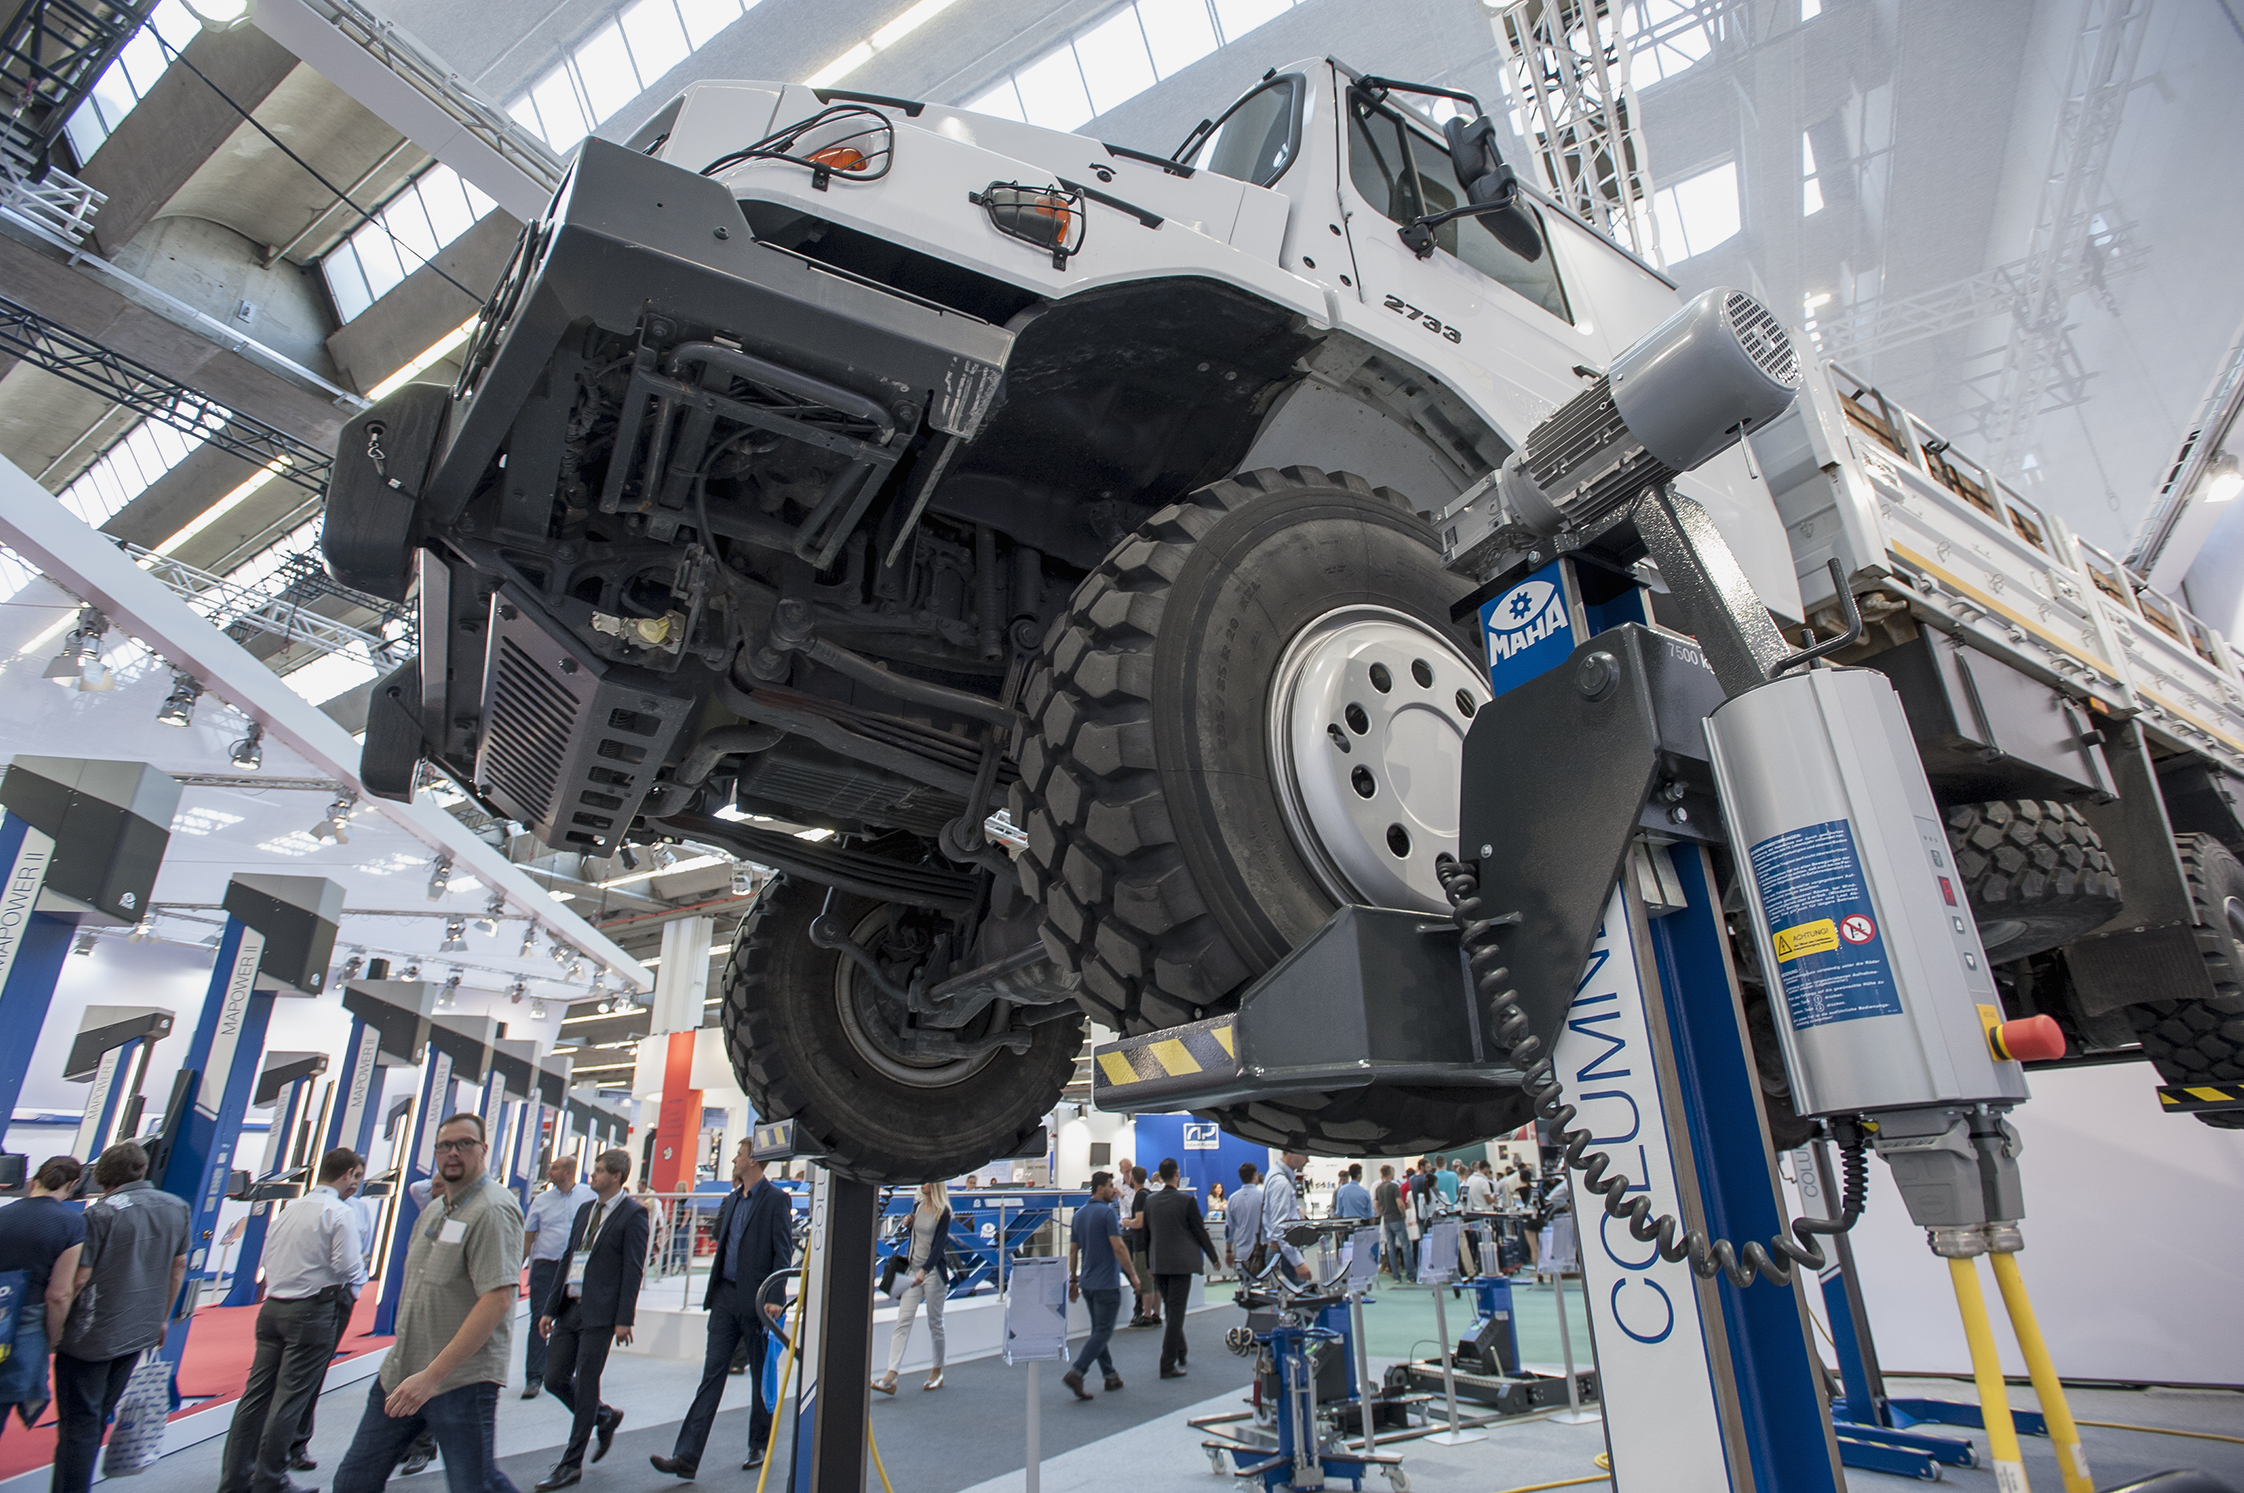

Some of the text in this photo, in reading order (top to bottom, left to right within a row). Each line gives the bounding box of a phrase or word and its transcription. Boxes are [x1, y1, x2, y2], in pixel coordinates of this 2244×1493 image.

[1383, 294, 1463, 344] 2733
[1488, 593, 1568, 667] MAHA
[1667, 642, 1716, 675] 7500 k
[0, 852, 45, 971] APOWER II
[1793, 928, 1829, 941] ACHTUNG!
[221, 956, 256, 1035] MAPOWER
[86, 1066, 113, 1120] MAPOWER
[350, 1047, 374, 1108] MAPOWER
[428, 1071, 446, 1122] MAPOWER
[1568, 922, 1674, 1344] COLUMN
[1796, 1148, 1818, 1198] COLU
